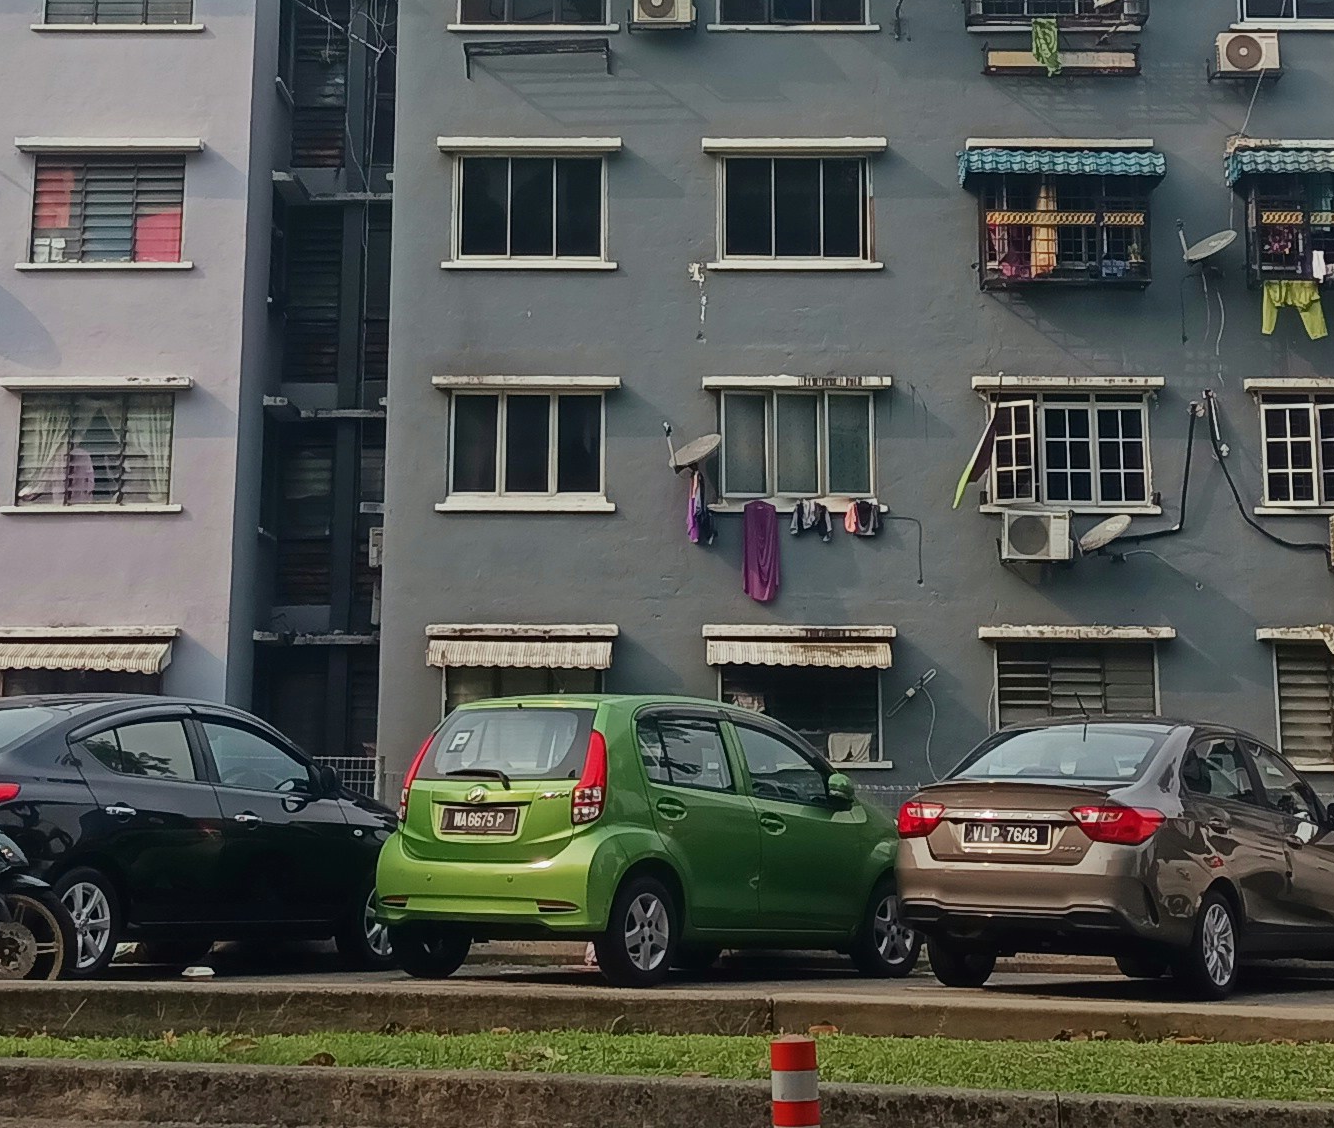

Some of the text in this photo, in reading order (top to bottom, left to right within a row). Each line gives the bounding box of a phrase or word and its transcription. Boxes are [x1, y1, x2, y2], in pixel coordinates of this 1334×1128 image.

[449, 732, 471, 751] P
[973, 826, 1038, 842] VLP 7643
